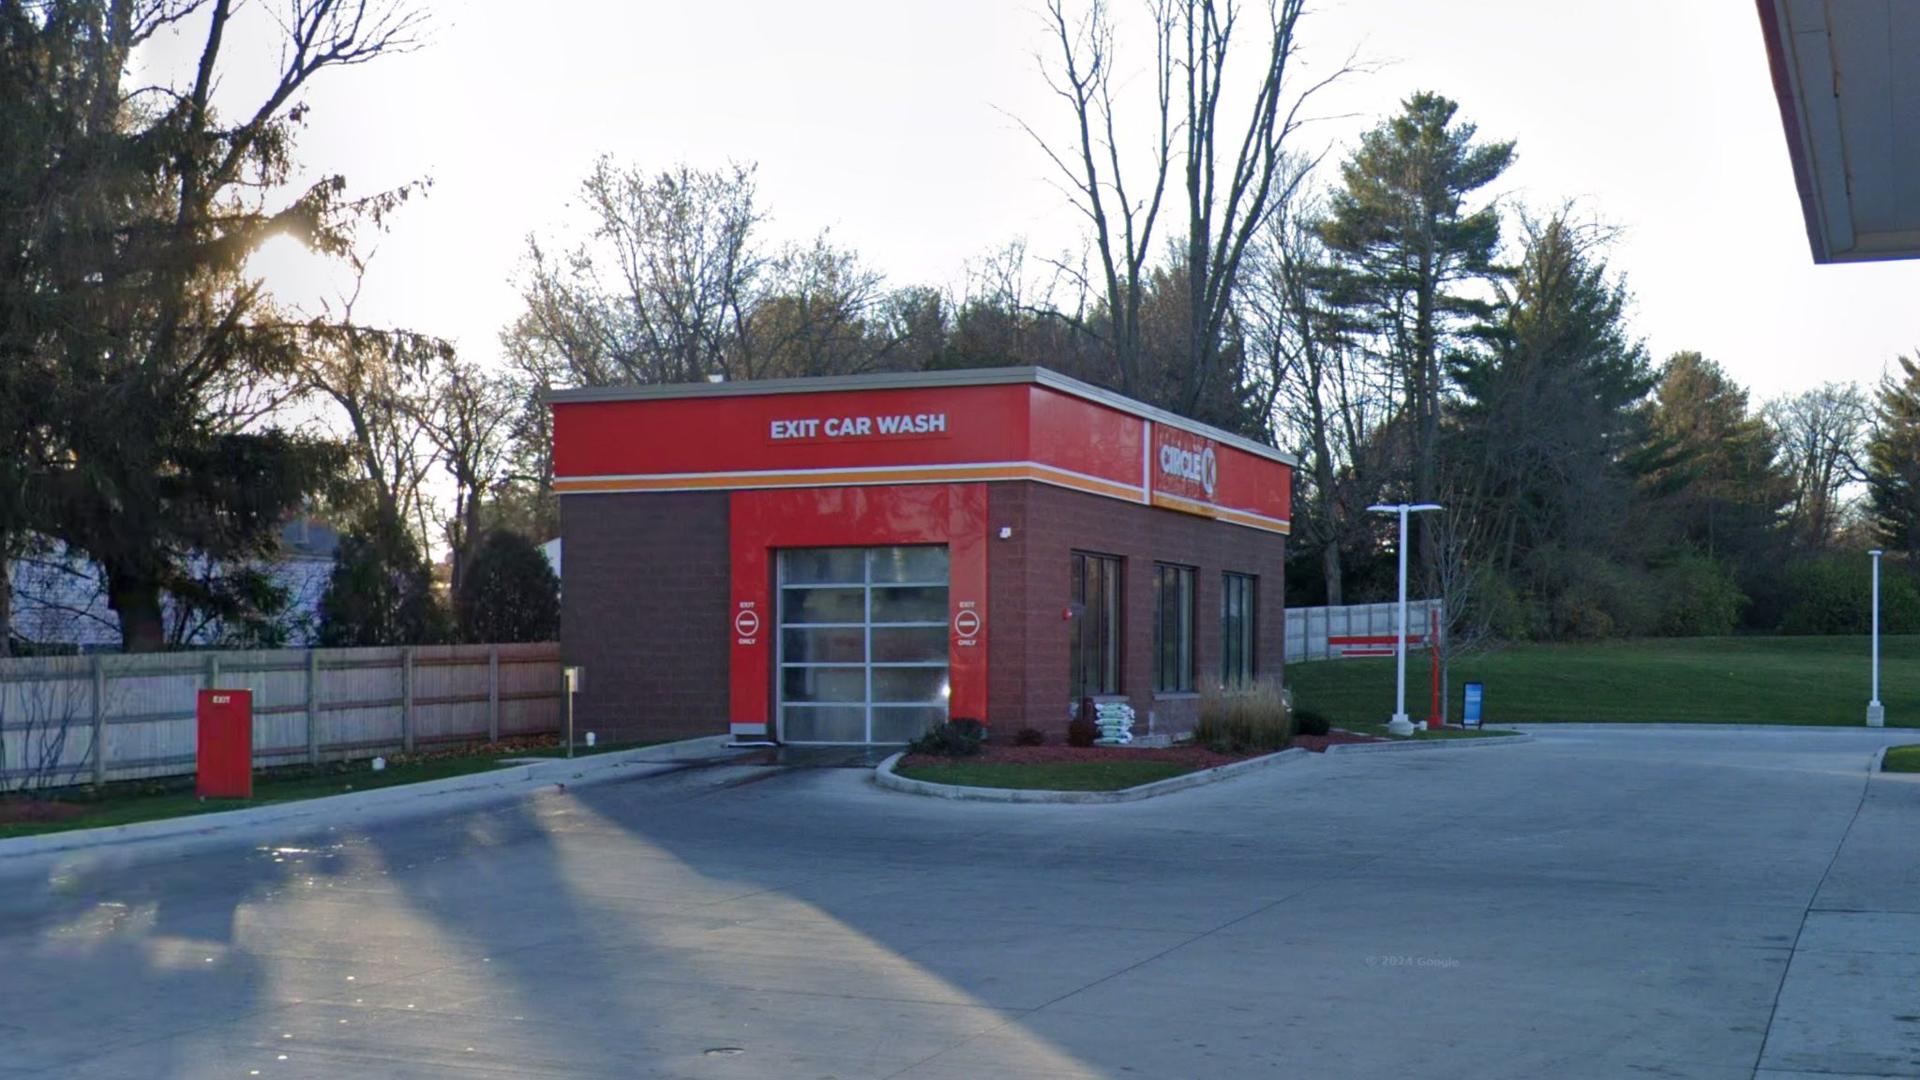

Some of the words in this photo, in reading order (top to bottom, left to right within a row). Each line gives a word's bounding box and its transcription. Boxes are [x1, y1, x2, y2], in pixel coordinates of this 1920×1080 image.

[770, 420, 819, 439] EXIT
[824, 417, 872, 437] CAR
[877, 414, 945, 434] WASH
[1160, 444, 1202, 481] CIRCLE
